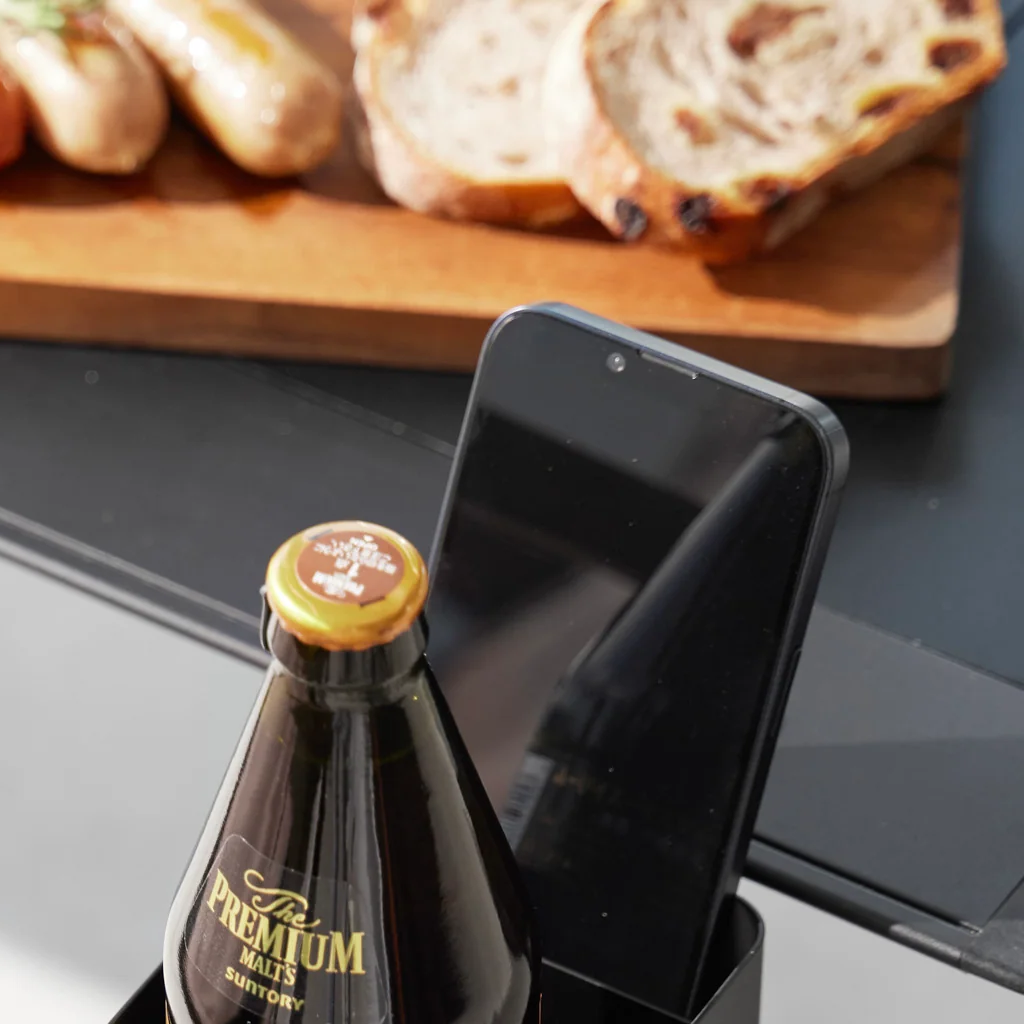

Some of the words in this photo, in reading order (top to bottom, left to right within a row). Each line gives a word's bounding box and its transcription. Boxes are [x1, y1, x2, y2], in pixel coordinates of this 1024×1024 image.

[207, 868, 366, 975] PREMIUM
[244, 868, 321, 928] The
[225, 966, 305, 1011] SUNTORY
[239, 945, 297, 987] MALT'S
